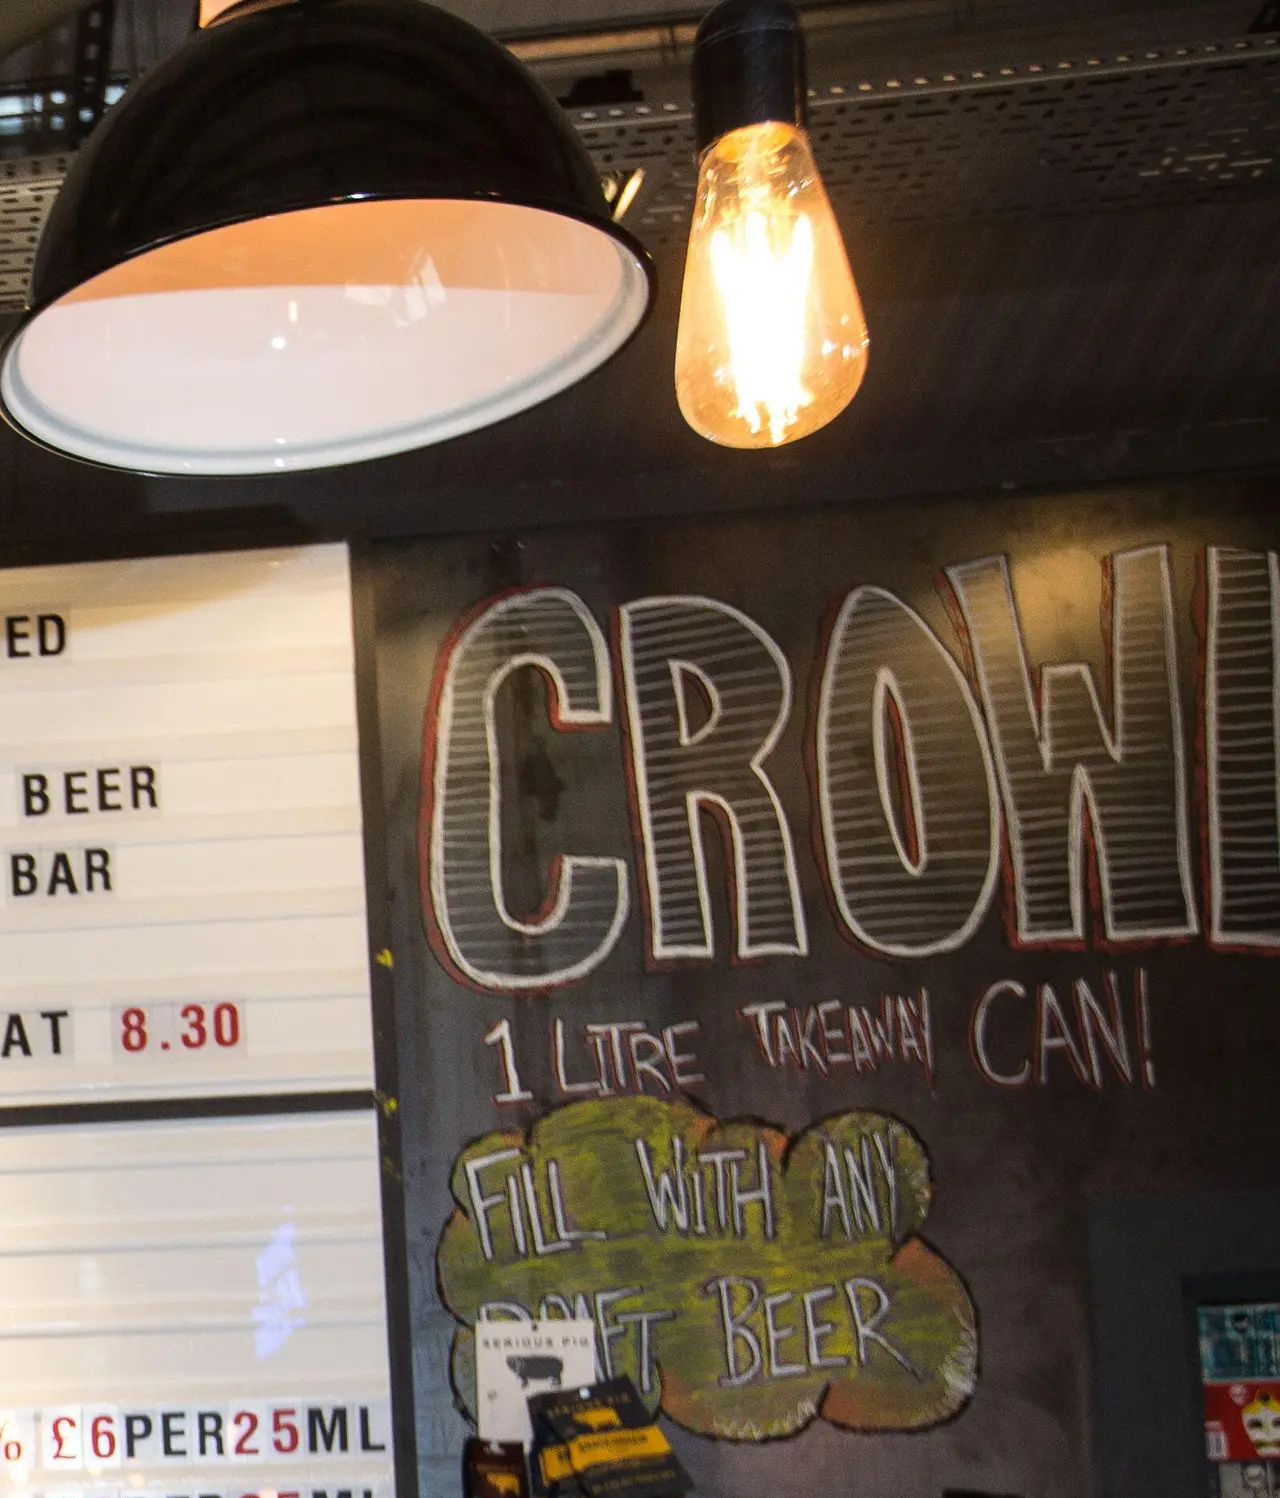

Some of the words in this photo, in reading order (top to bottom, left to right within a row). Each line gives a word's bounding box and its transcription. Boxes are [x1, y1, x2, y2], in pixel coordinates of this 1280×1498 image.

[22, 765, 159, 817] BEER
[10, 847, 112, 897] BAR
[2, 1011, 68, 1058] AT
[121, 1002, 239, 1052] 8.30
[484, 1018, 532, 1104] 1
[552, 1018, 707, 1097] LITRE
[740, 985, 937, 1085] TAKEAWAY
[971, 967, 1156, 1090] CAN!
[464, 1147, 606, 1262] FILL
[816, 1122, 901, 1243] ANY
[702, 1276, 930, 1387] BEER
